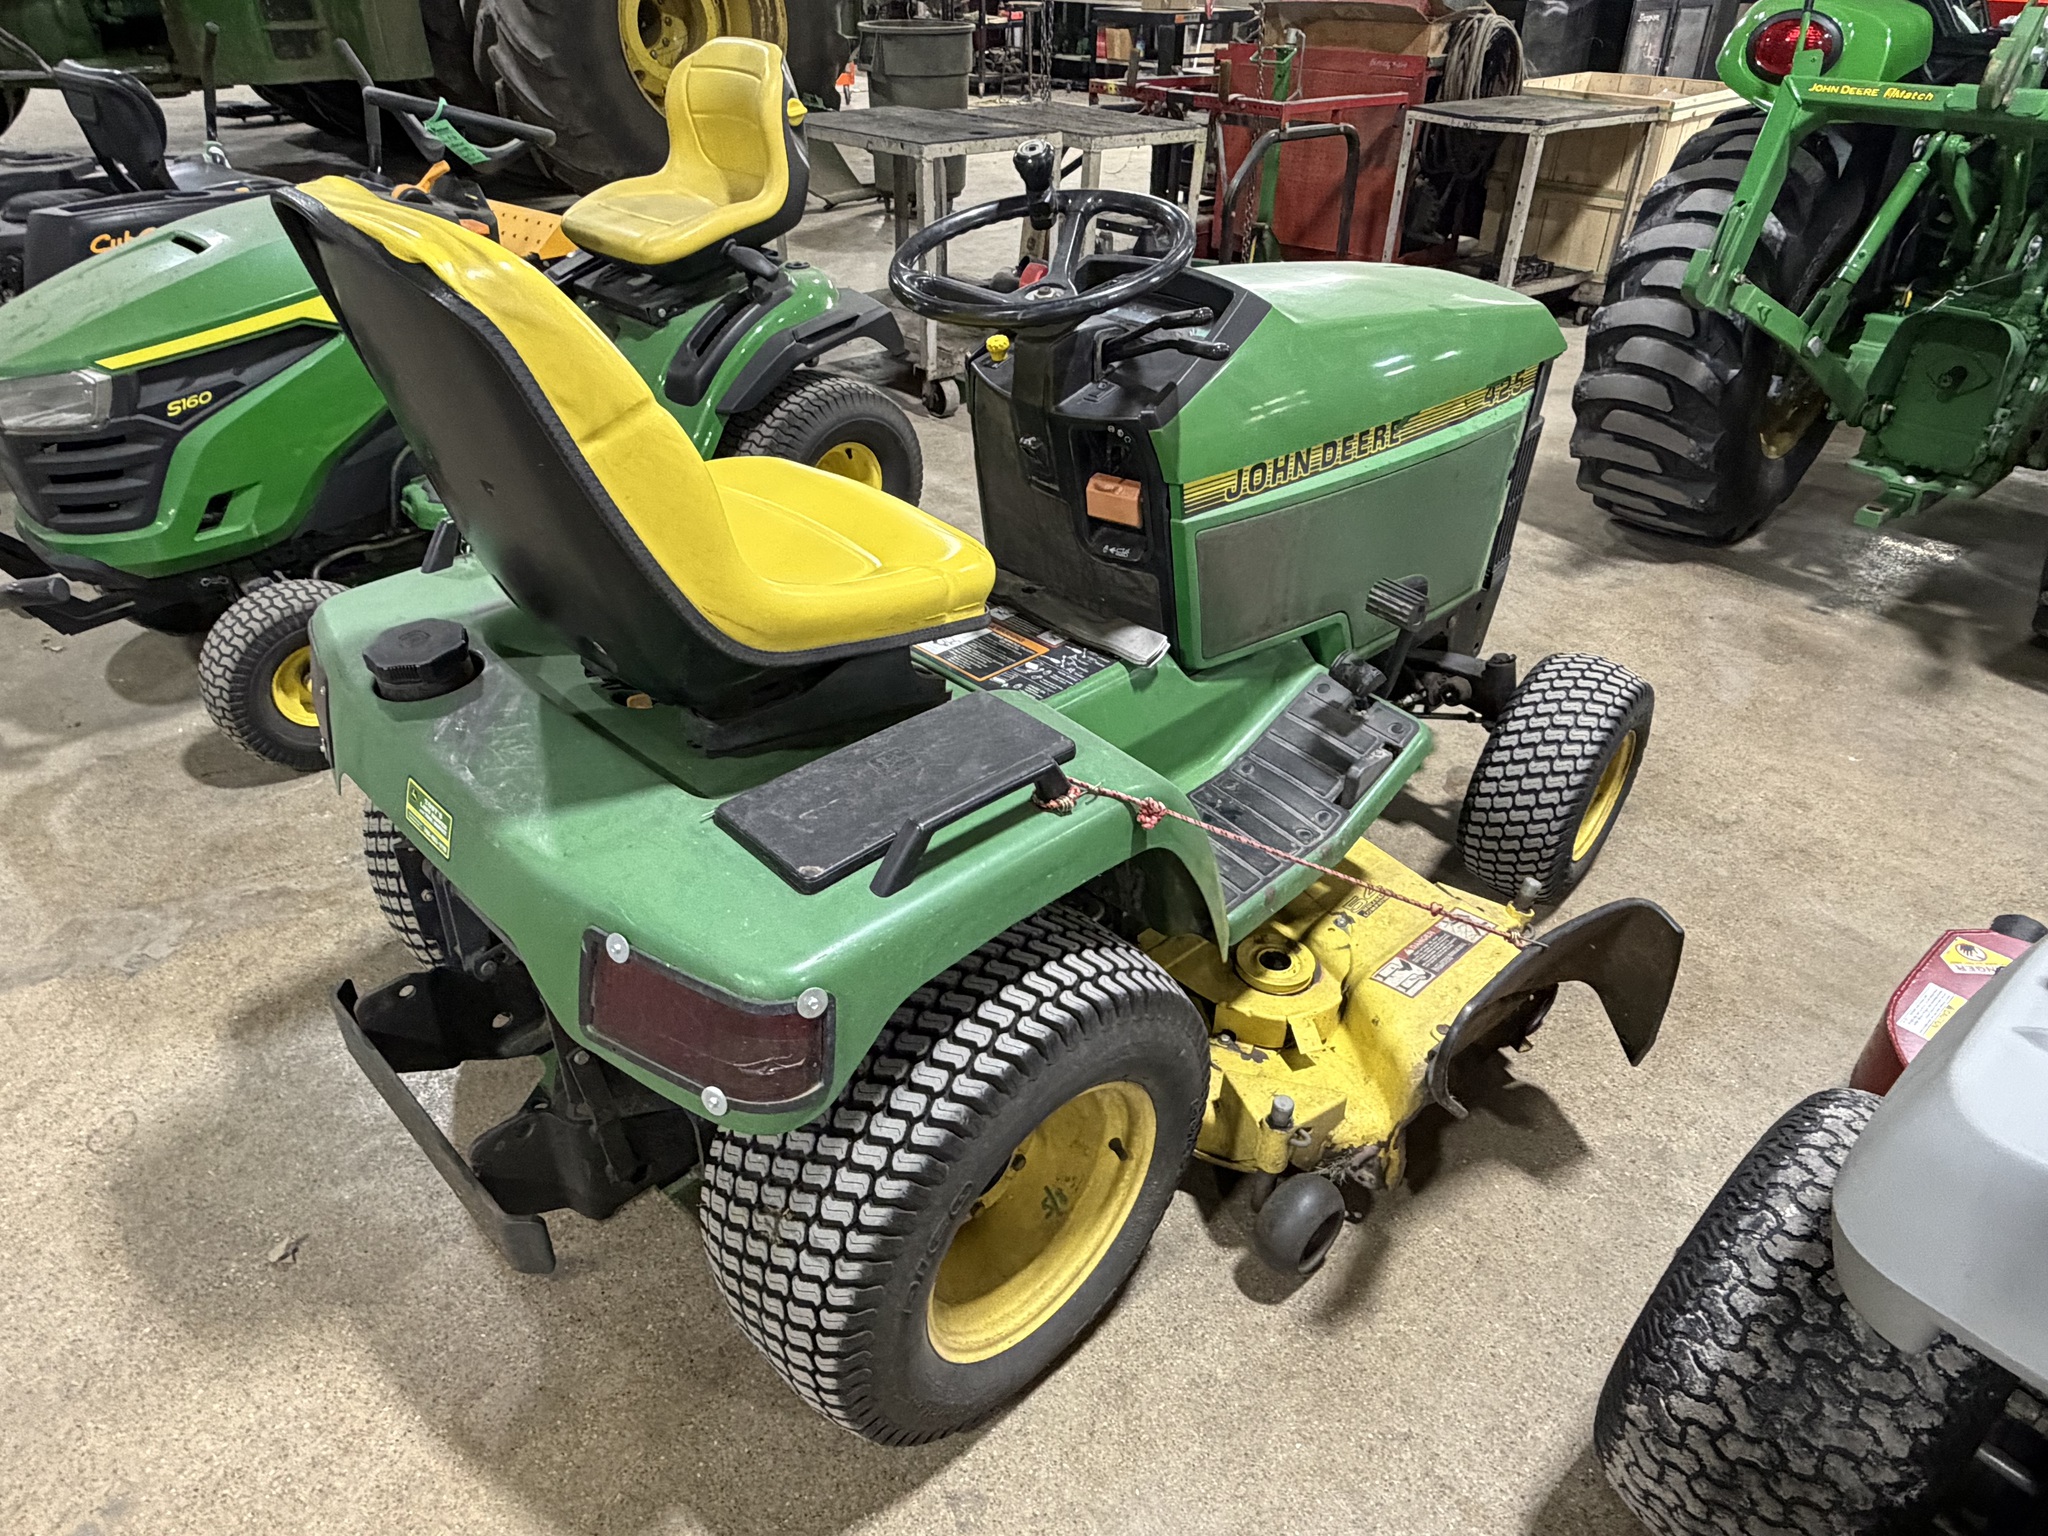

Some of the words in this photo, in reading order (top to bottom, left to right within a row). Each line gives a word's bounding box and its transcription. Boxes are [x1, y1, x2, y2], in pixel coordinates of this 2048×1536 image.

[1808, 83, 1839, 94] JOHN
[1840, 85, 1880, 97] DEERE
[167, 391, 212, 417] S160
[1484, 369, 1525, 407] 425
[1225, 447, 1312, 501] JOHN
[1319, 418, 1403, 471] DEERE
